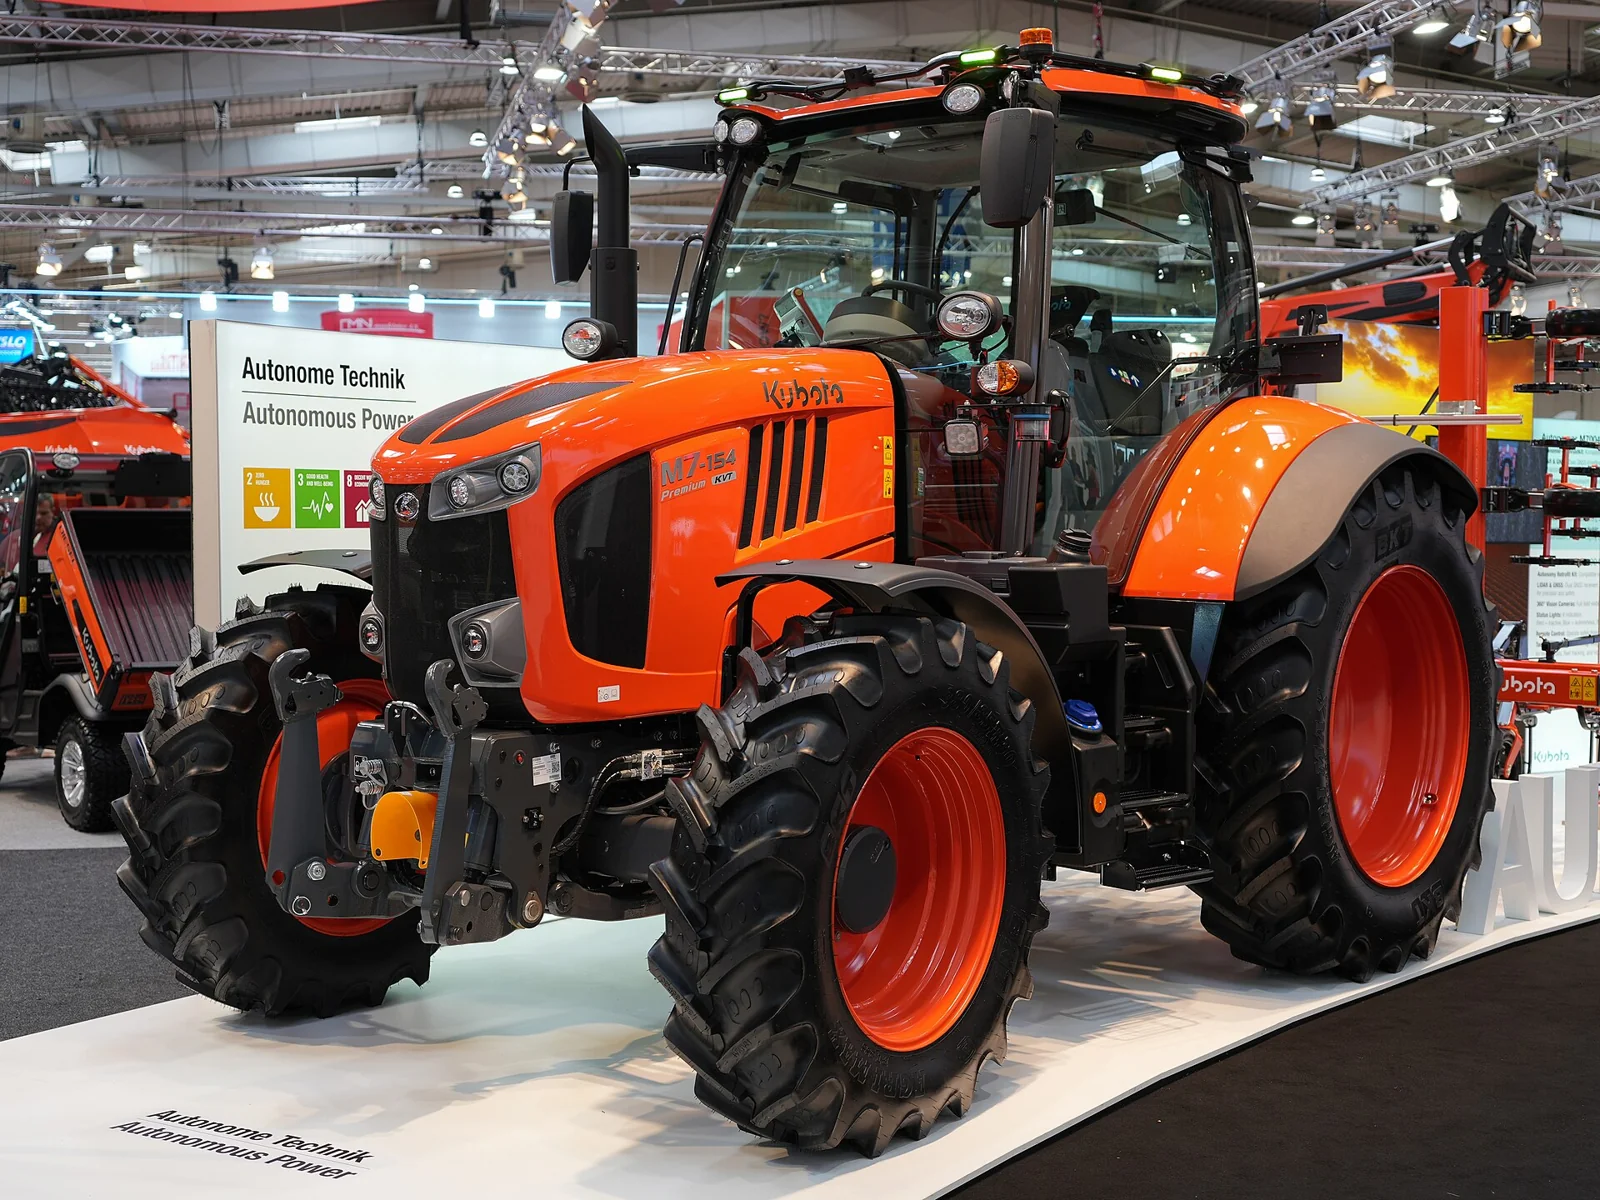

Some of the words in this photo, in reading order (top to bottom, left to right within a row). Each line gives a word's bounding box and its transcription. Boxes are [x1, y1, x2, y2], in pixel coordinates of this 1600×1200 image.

[242, 356, 335, 386] Autonome
[339, 364, 406, 390] Technik
[762, 377, 845, 410] Kubota
[242, 401, 357, 430] Autonomous
[361, 408, 415, 431] Power
[246, 472, 253, 486] 2
[297, 473, 304, 487] 3
[346, 474, 353, 488] 8
[660, 448, 738, 488] M7-154
[660, 480, 706, 502] Premium
[714, 472, 734, 485] KVT
[82, 626, 100, 681] Kubota
[1501, 674, 1556, 696] ubota
[1533, 749, 1569, 763] Kubota
[1456, 765, 1600, 936] AU
[110, 1121, 269, 1161] Autonomous
[265, 1155, 358, 1181] Power
[147, 1110, 273, 1141] Autonome
[273, 1135, 374, 1164] Technik
